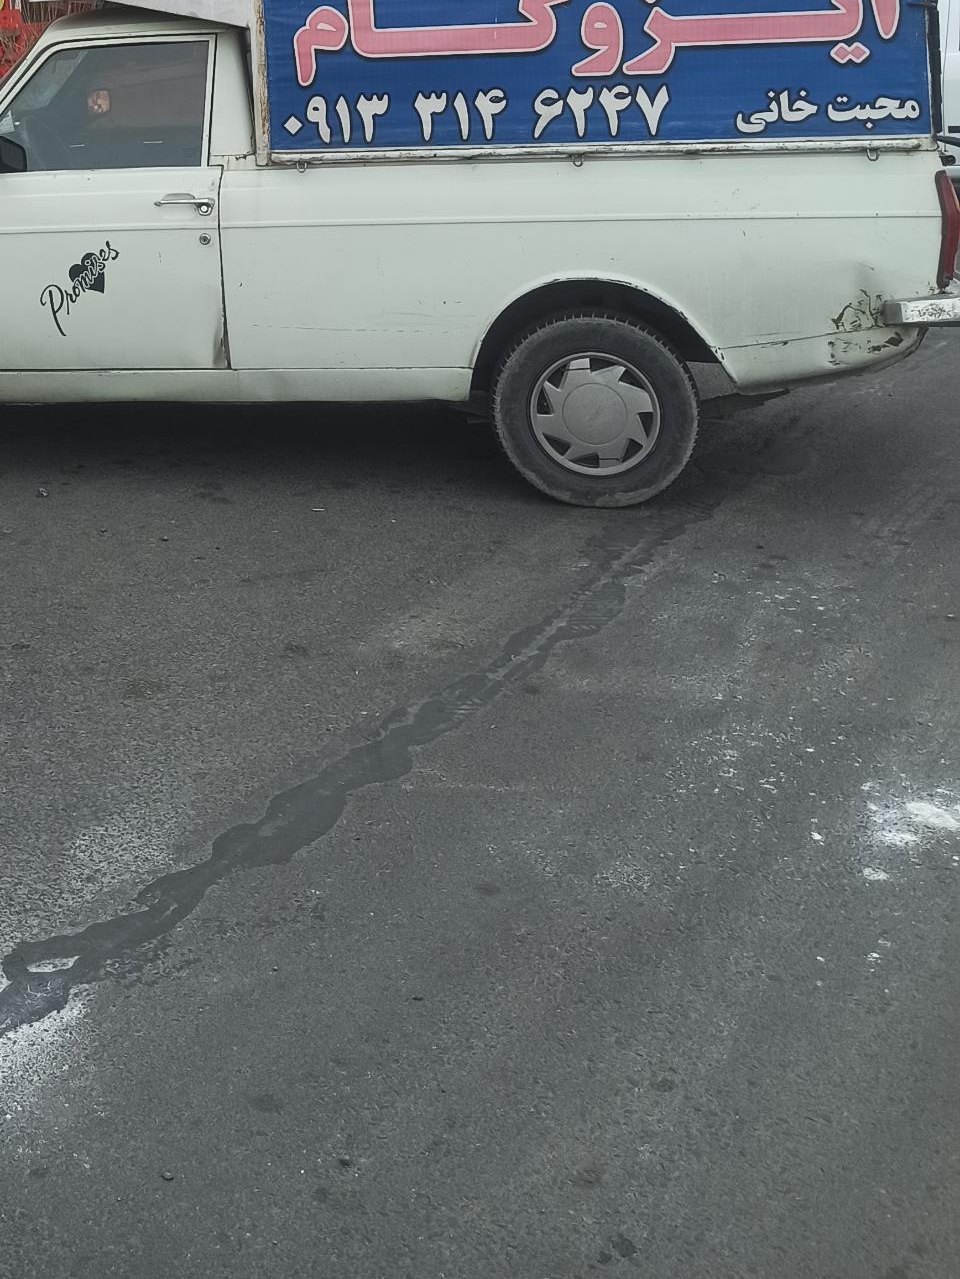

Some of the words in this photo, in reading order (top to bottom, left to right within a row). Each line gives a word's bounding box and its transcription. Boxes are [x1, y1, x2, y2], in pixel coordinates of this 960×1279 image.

[283, 92, 389, 144] ۰۹۱۳
[414, 88, 507, 142] ۳۱۴
[532, 84, 671, 139] ۶۲۴۷
[735, 88, 819, 133] خانی
[826, 91, 921, 124] محبت
[39, 239, 120, 337] Promises
